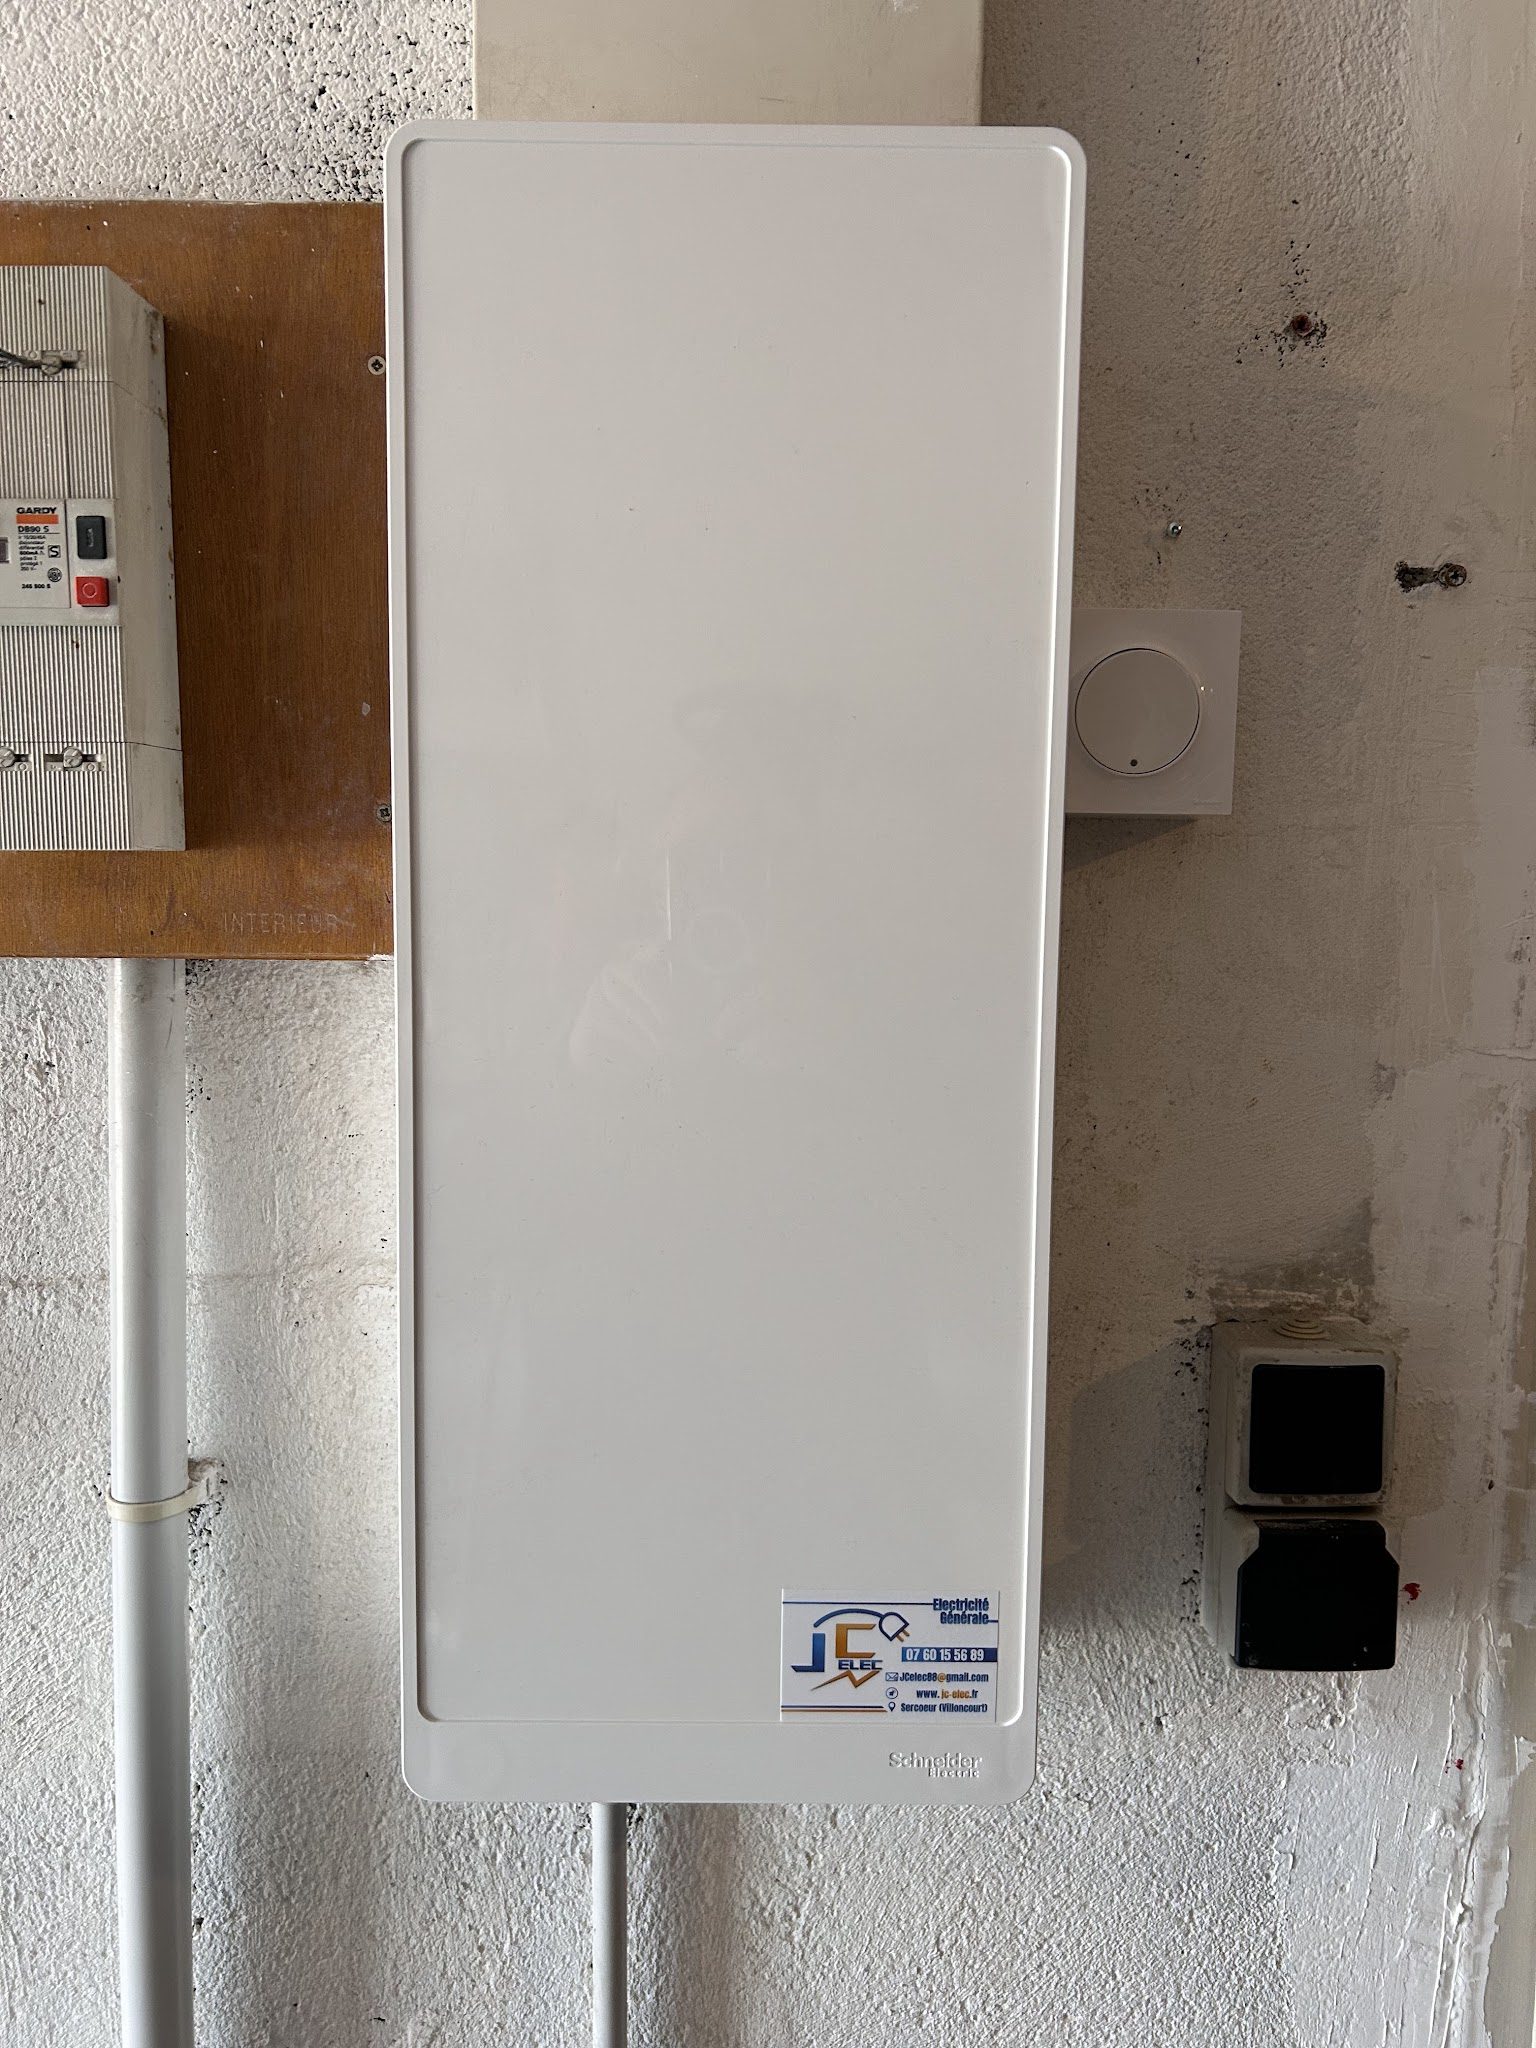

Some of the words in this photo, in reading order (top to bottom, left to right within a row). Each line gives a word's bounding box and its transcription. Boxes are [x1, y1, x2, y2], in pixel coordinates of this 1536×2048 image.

[222, 912, 339, 936] INTERIEUR
[940, 1611, 990, 1625] Générale
[906, 1648, 921, 1661] 07
[923, 1648, 937, 1661] 60
[939, 1648, 952, 1661] 15
[954, 1649, 968, 1661] 56
[970, 1649, 985, 1661] 89
[837, 1659, 883, 1671] ELEC
[899, 1672, 989, 1683] JCelec88@gmail.com
[900, 1703, 937, 1712] Sercoeur
[888, 1752, 983, 1768] Schneider
[928, 1767, 980, 1778] Electric
